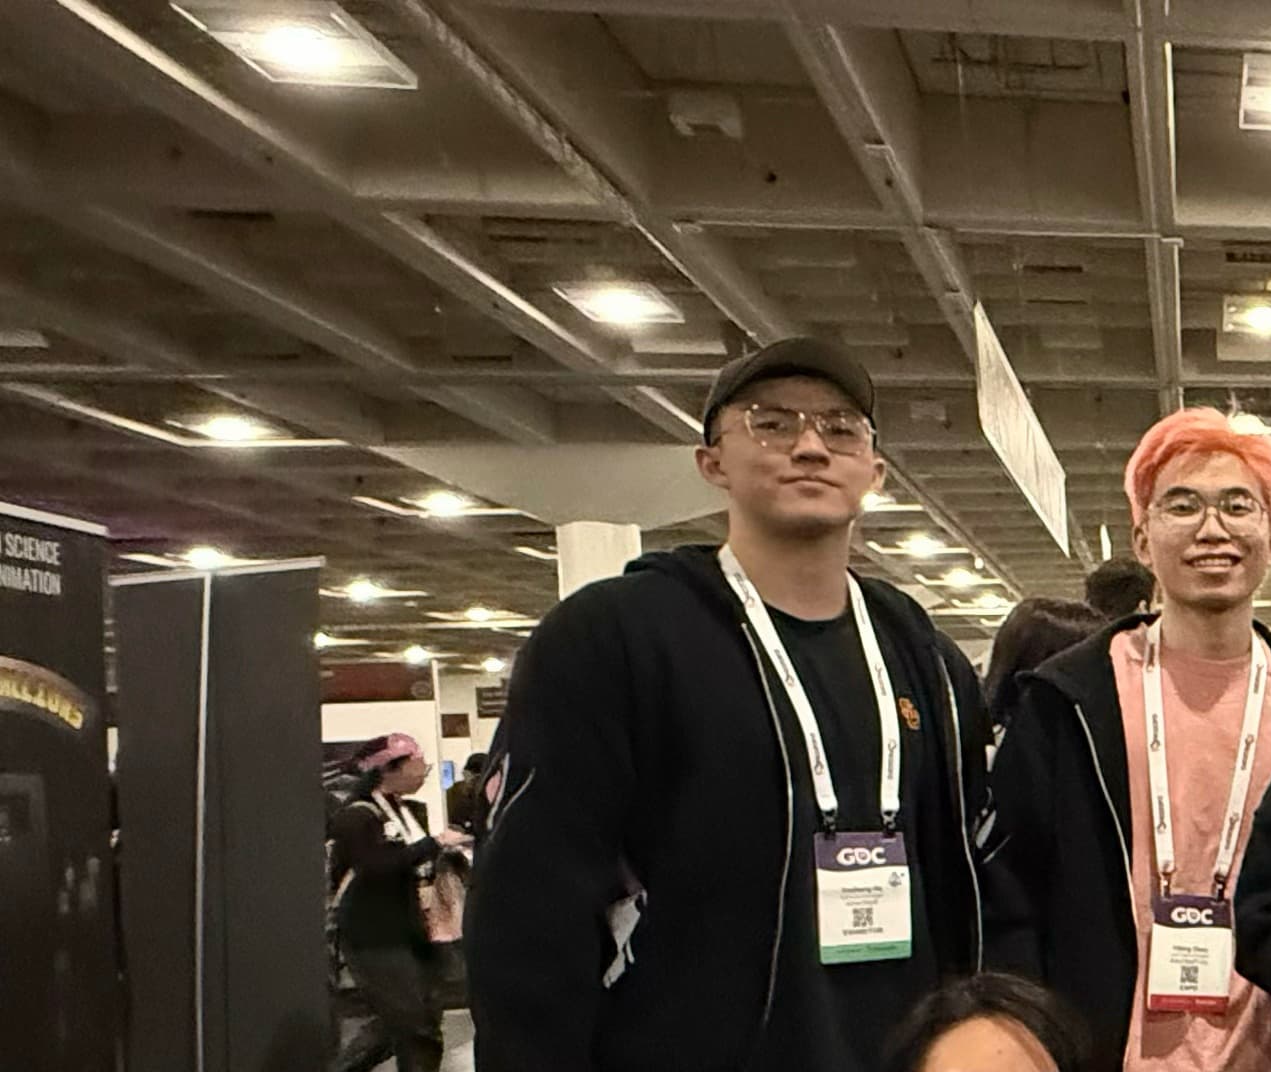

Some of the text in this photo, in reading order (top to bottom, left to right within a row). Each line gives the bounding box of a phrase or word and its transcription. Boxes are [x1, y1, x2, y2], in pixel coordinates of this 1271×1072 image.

[6, 532, 61, 566] SCIENCE
[836, 846, 887, 866] GDC
[1170, 906, 1214, 925] GDC
